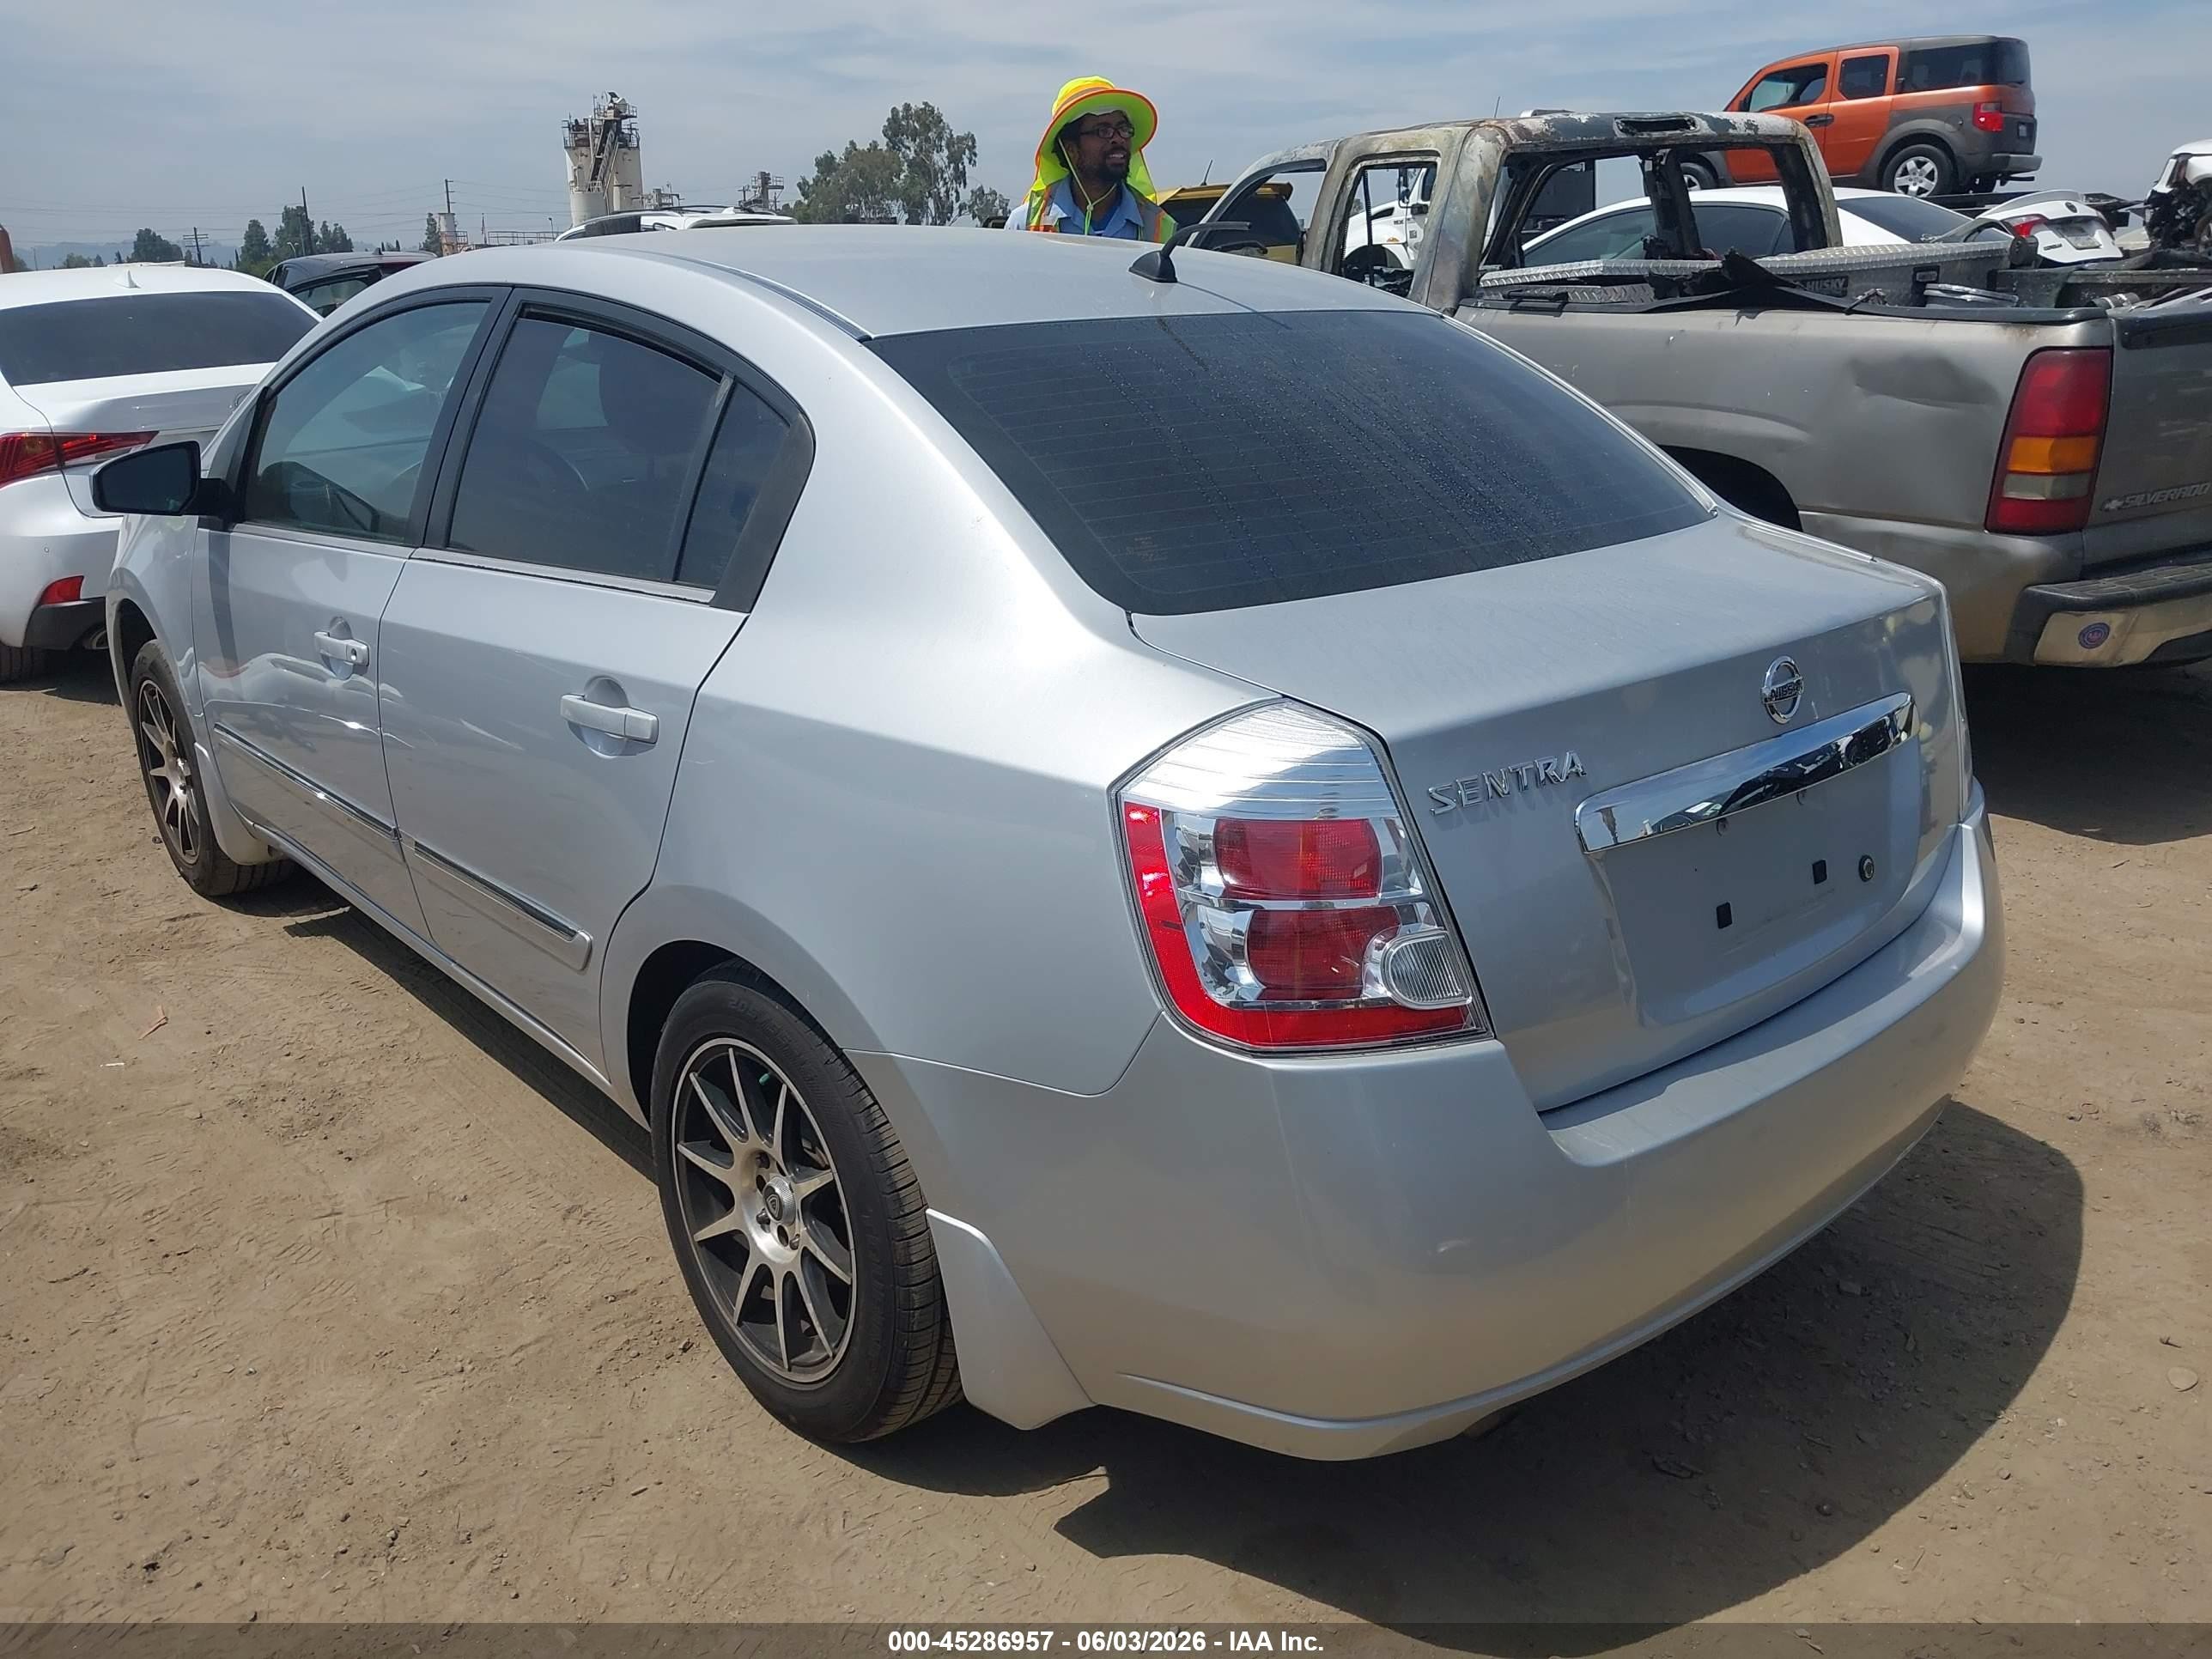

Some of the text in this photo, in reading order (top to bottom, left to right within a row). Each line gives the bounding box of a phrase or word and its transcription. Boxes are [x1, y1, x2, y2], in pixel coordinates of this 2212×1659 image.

[1806, 278, 1846, 291] HUSKY
[2123, 482, 2212, 508] SILVERADO
[1428, 750, 1586, 815] SENTRA
